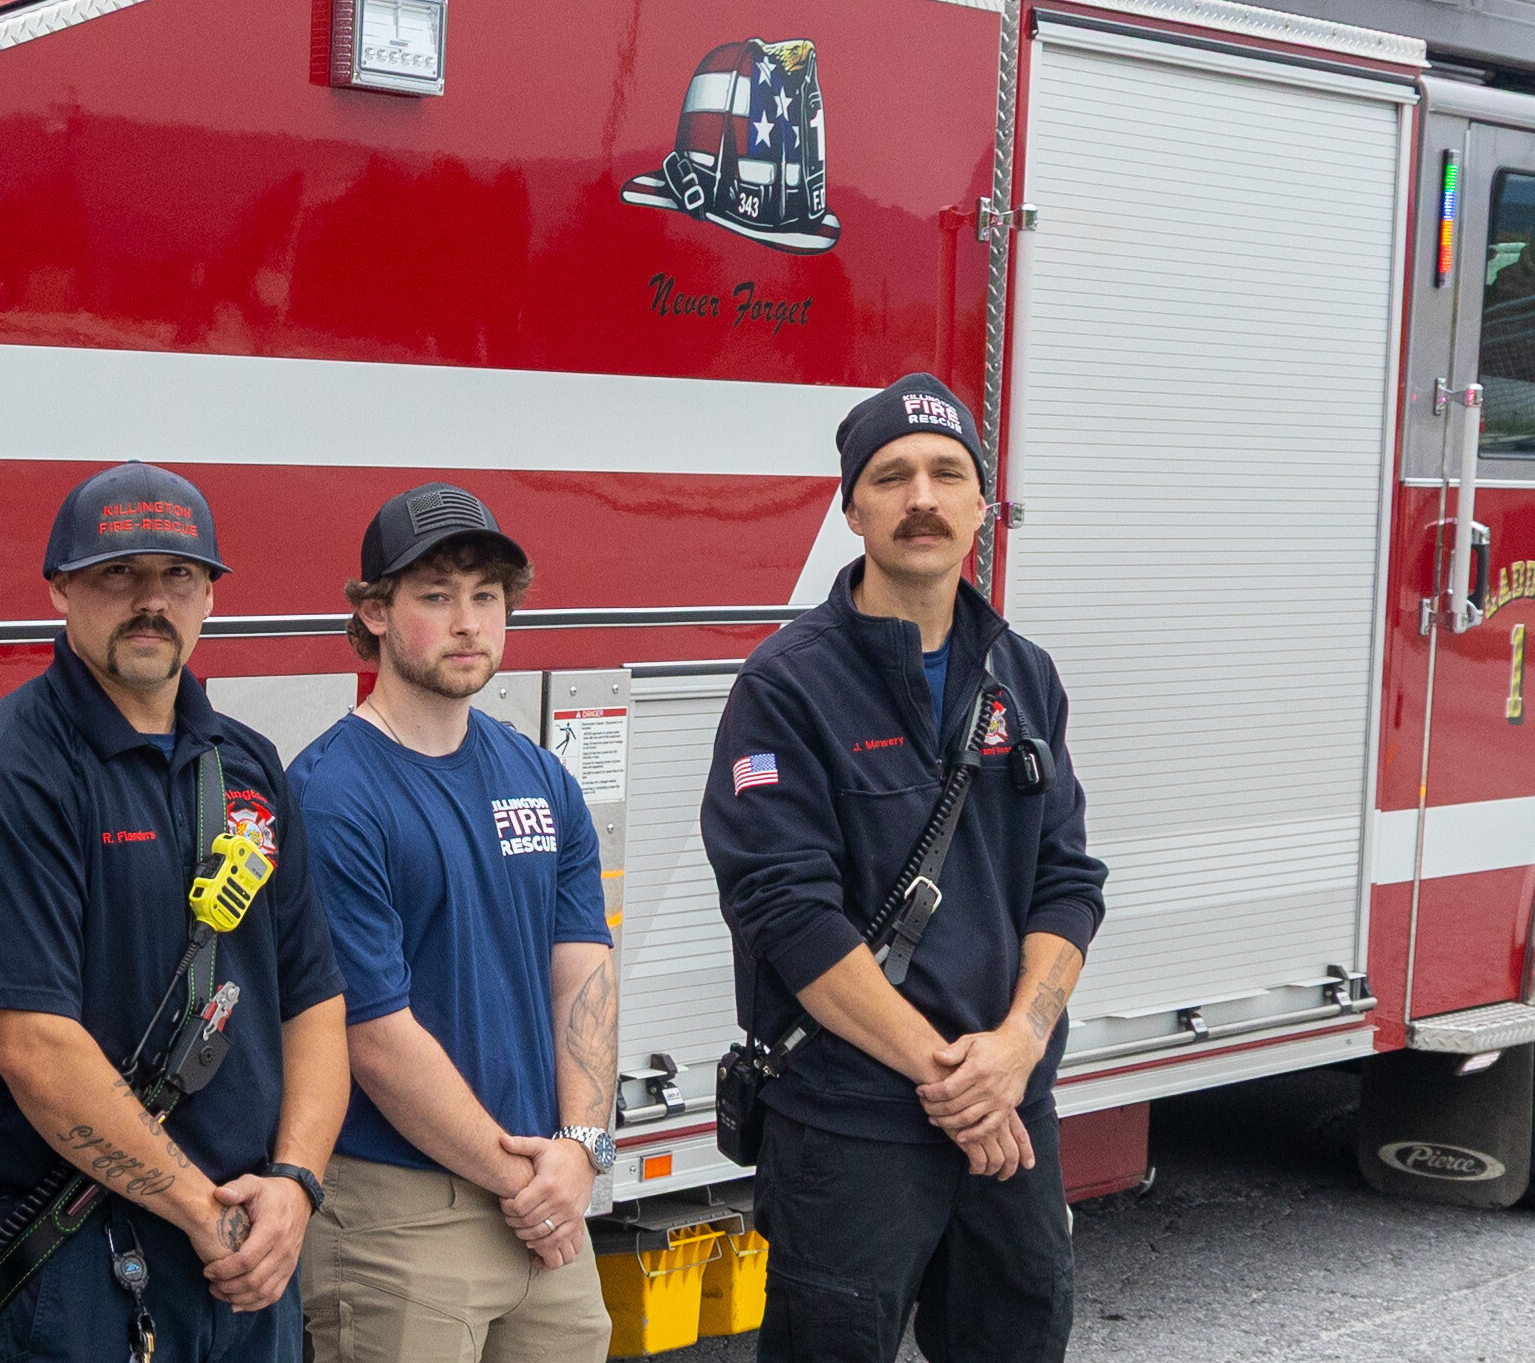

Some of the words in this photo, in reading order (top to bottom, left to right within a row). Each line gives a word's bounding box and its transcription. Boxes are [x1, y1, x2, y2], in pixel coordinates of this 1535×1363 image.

[738, 193, 765, 218] 343
[648, 272, 720, 317] Never
[733, 280, 813, 335] Forget
[905, 399, 961, 425] FIRE
[908, 414, 962, 434] RESCUE
[103, 501, 191, 518] KILLINGTON
[98, 518, 198, 538] FIRE-RESCUE
[1506, 624, 1524, 723] 1
[582, 709, 604, 718] DANGER
[492, 797, 549, 812] ILLINGTON
[493, 808, 556, 839] FIRE
[101, 832, 114, 844] R.
[500, 835, 558, 857] RESCUE
